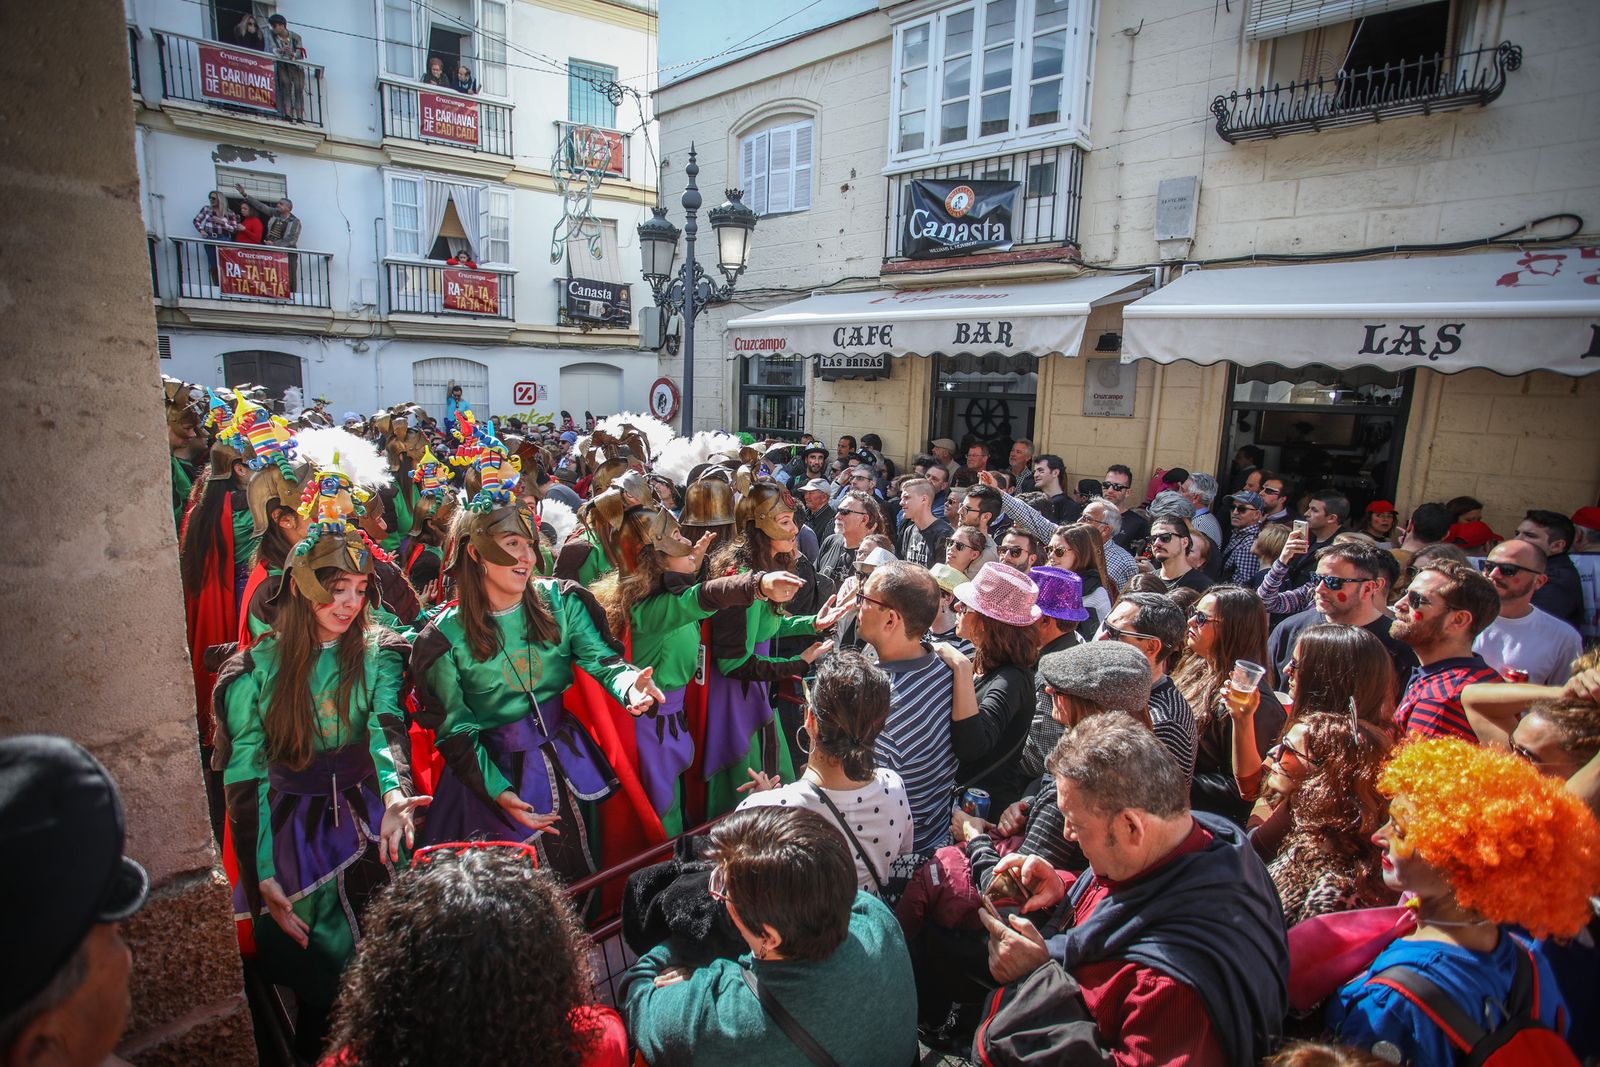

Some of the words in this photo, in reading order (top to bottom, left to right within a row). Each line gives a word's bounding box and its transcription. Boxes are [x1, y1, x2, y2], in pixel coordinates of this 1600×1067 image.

[220, 51, 258, 66] Cruzcampo
[205, 63, 218, 79] EL
[221, 66, 273, 91] CARNAVAL
[206, 78, 219, 93] DE
[222, 81, 246, 98] CADI
[424, 106, 434, 120] EL
[435, 108, 476, 129] CARNAVAL
[423, 119, 434, 132] DE
[435, 121, 454, 136] CADI
[910, 208, 1005, 242] Canasta
[237, 251, 273, 261] Cruzcampo
[568, 281, 612, 300] Canasta
[735, 337, 786, 352] Cruzcampo
[833, 324, 894, 349] CAFE
[952, 321, 1014, 348] BAR
[1358, 323, 1466, 361] LAS
[822, 358, 842, 367] LAS
[846, 358, 883, 367] BRISAS
